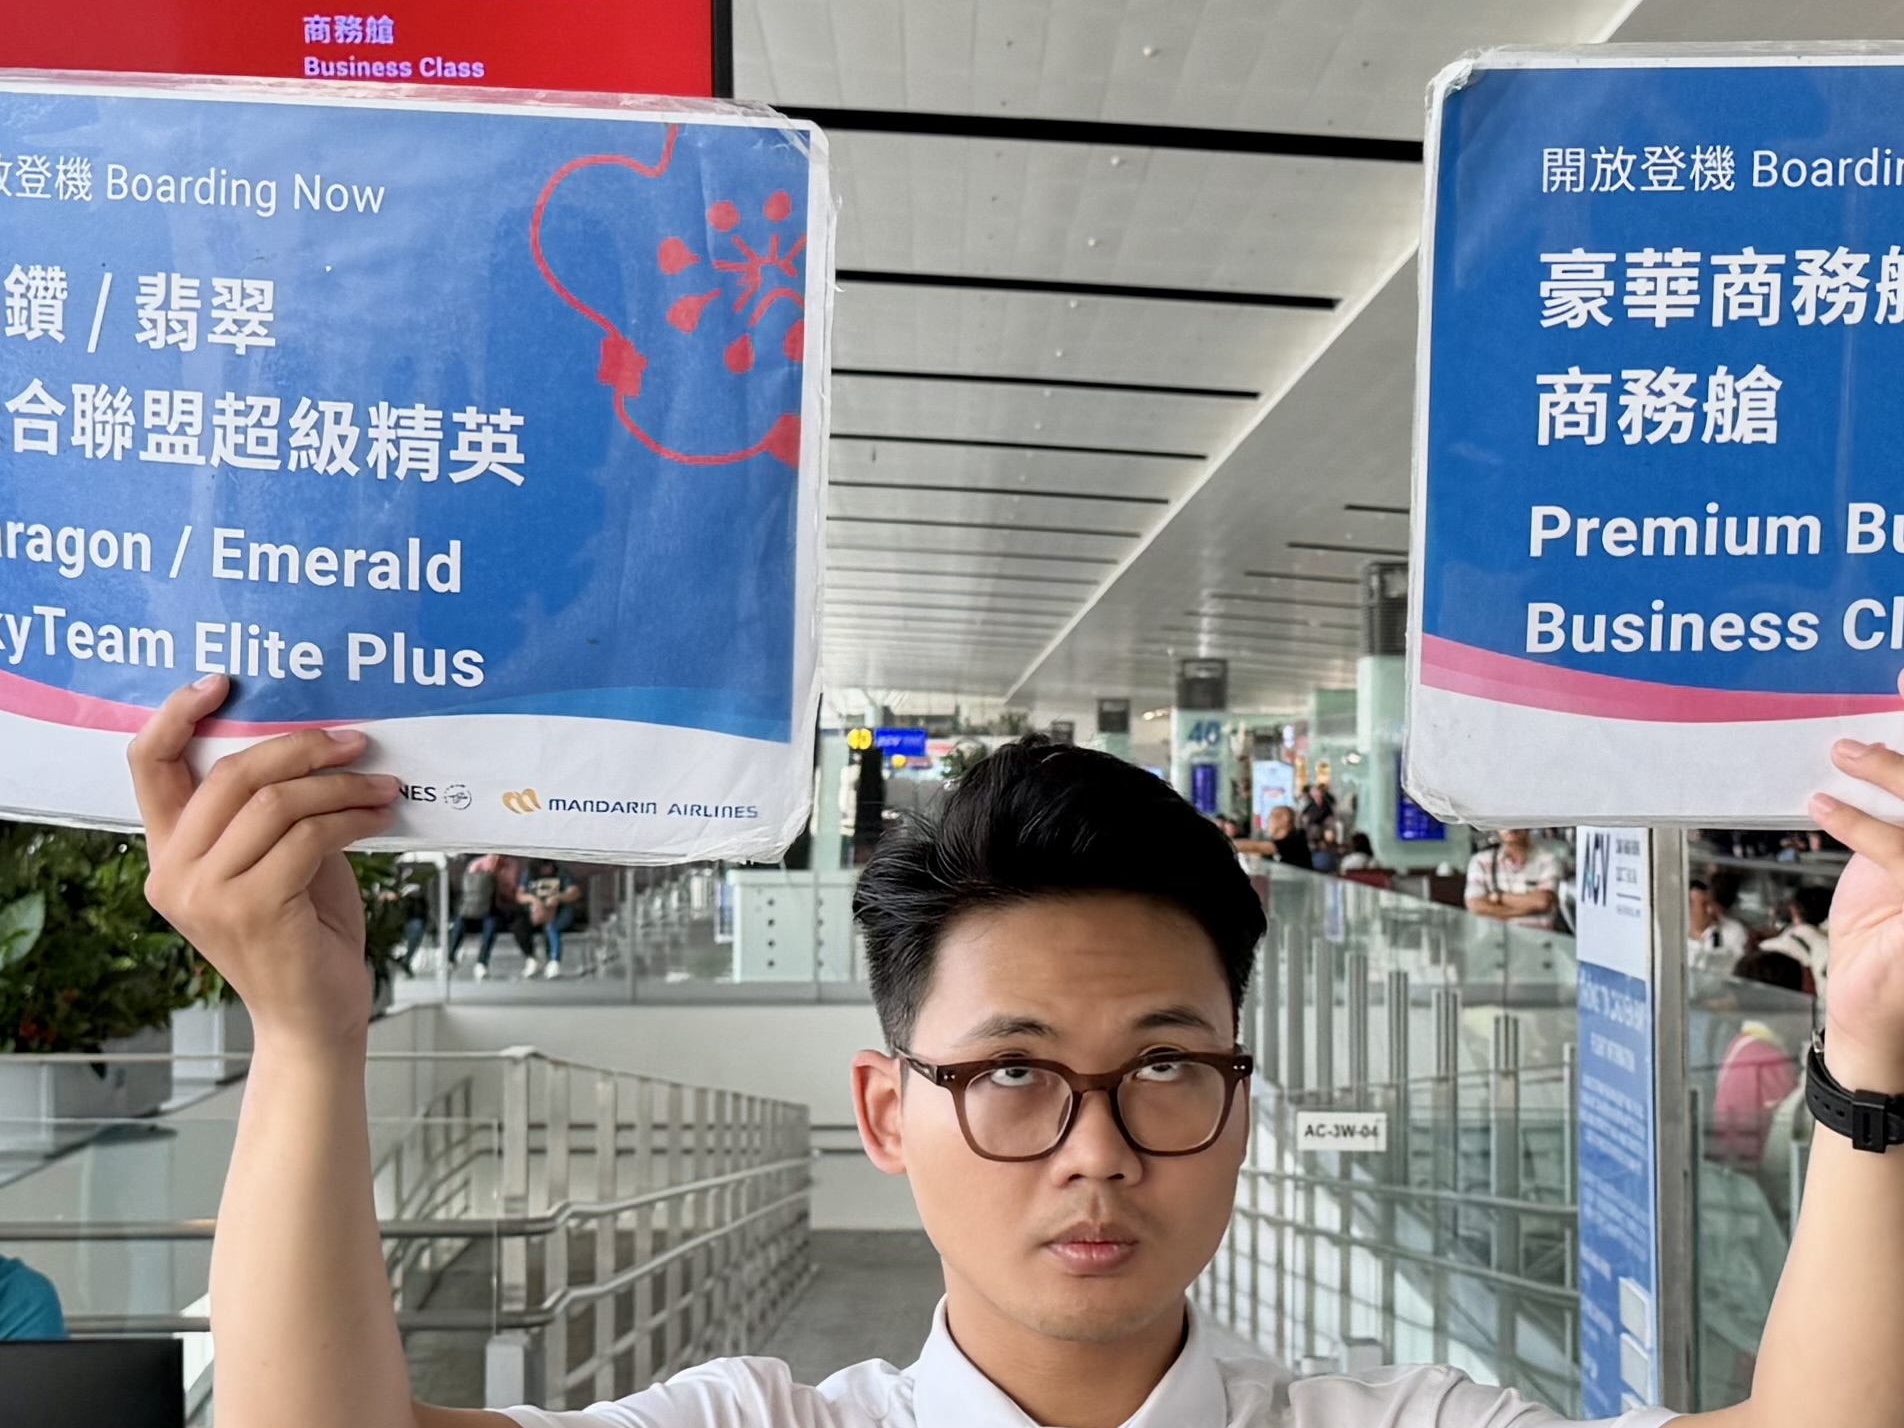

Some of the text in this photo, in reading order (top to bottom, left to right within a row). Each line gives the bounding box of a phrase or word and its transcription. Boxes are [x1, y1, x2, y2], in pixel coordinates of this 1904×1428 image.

[303, 15, 394, 45] 商務艙
[304, 56, 485, 78] Business Class
[106, 164, 278, 217] Boarding
[293, 174, 386, 215] Now
[1541, 145, 1737, 194] 開放登機
[88, 274, 111, 353] /
[135, 274, 277, 355] 翡翠
[1536, 363, 1782, 448] 商務艙
[1529, 500, 1822, 558] Premium
[169, 525, 192, 580] /
[212, 528, 462, 593] Emerald
[1524, 597, 1819, 654] Business
[194, 621, 323, 682] Elite
[347, 632, 486, 688] Plus
[548, 798, 759, 819] MANDARIN AIRLINES
